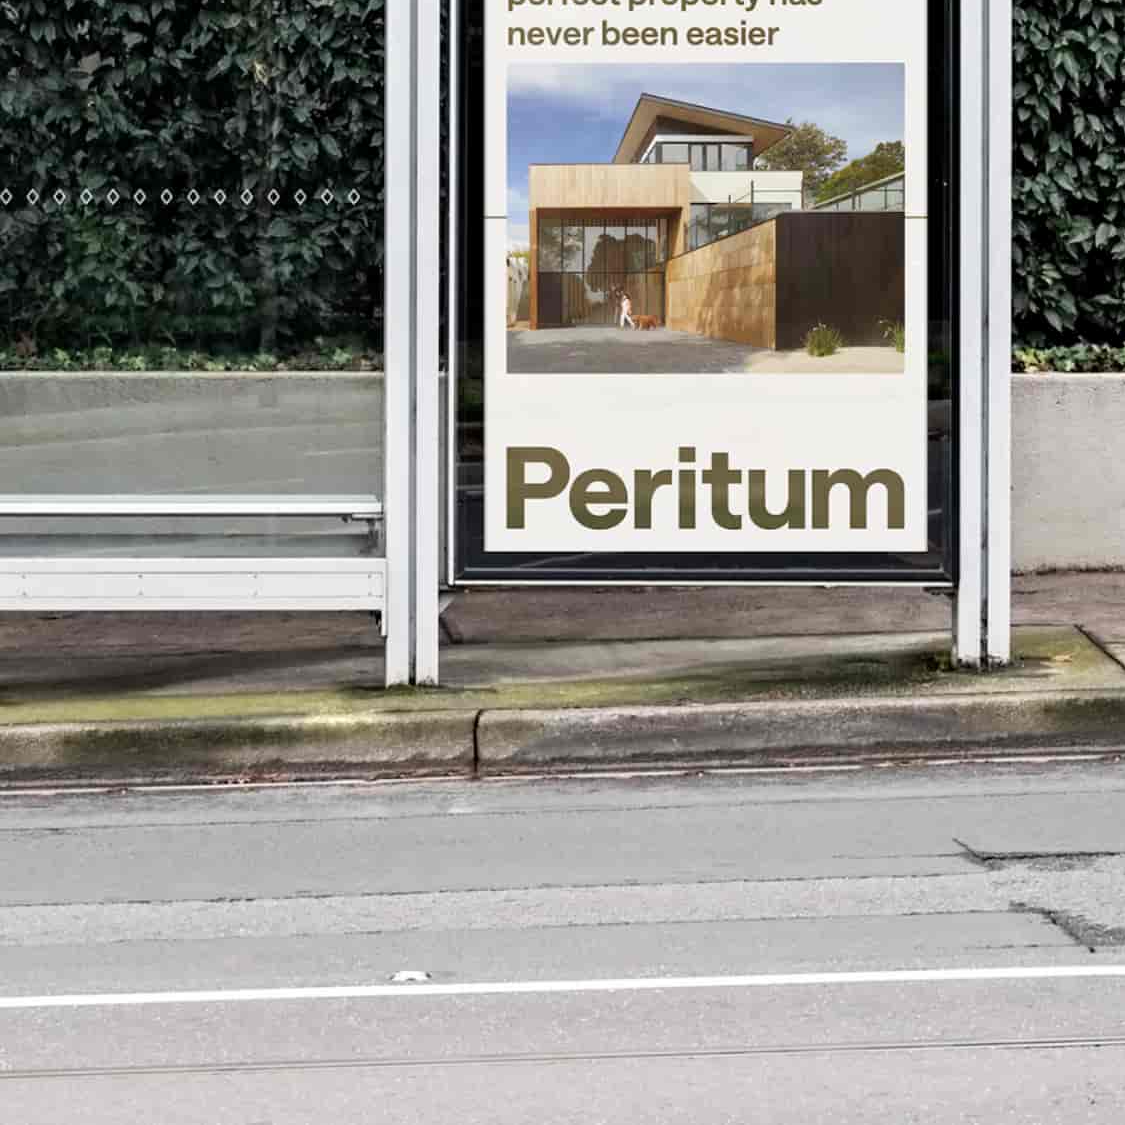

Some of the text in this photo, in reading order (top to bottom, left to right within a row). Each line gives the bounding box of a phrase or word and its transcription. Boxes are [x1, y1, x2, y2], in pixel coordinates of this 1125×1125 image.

[507, 20, 780, 46] never been easier
[506, 447, 905, 530] Peritum
